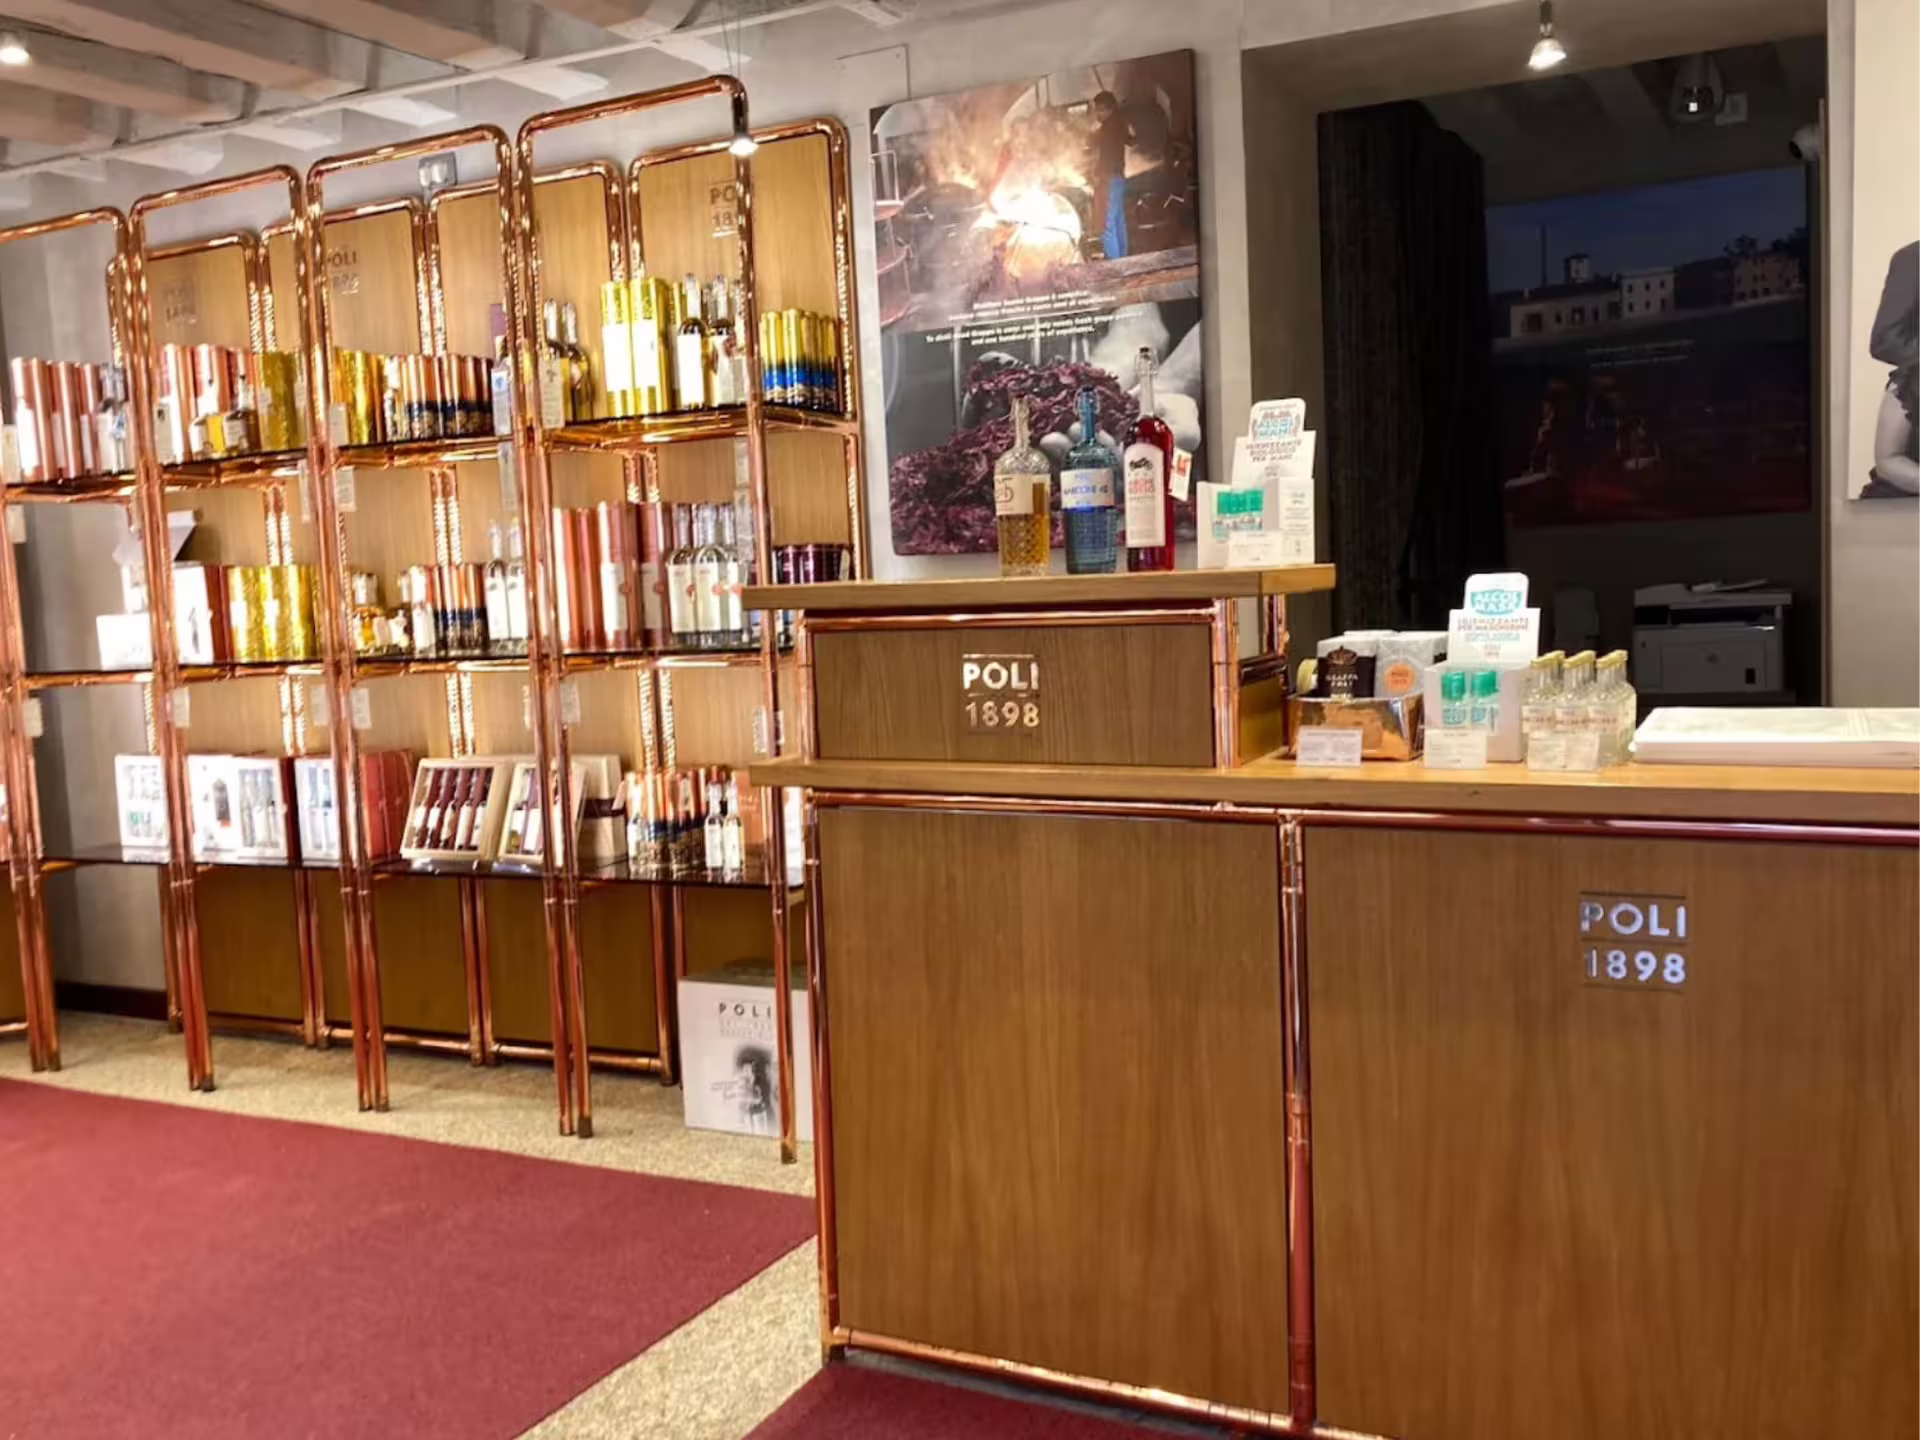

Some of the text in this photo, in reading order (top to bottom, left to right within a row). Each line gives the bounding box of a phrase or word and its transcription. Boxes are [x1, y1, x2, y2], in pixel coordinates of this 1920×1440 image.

[326, 250, 357, 267] OLI
[963, 661, 1039, 690] POLI
[965, 701, 1039, 727] 1898
[1581, 902, 1686, 937] POLI
[1585, 949, 1686, 983] 1898
[719, 1002, 771, 1018] POLI
